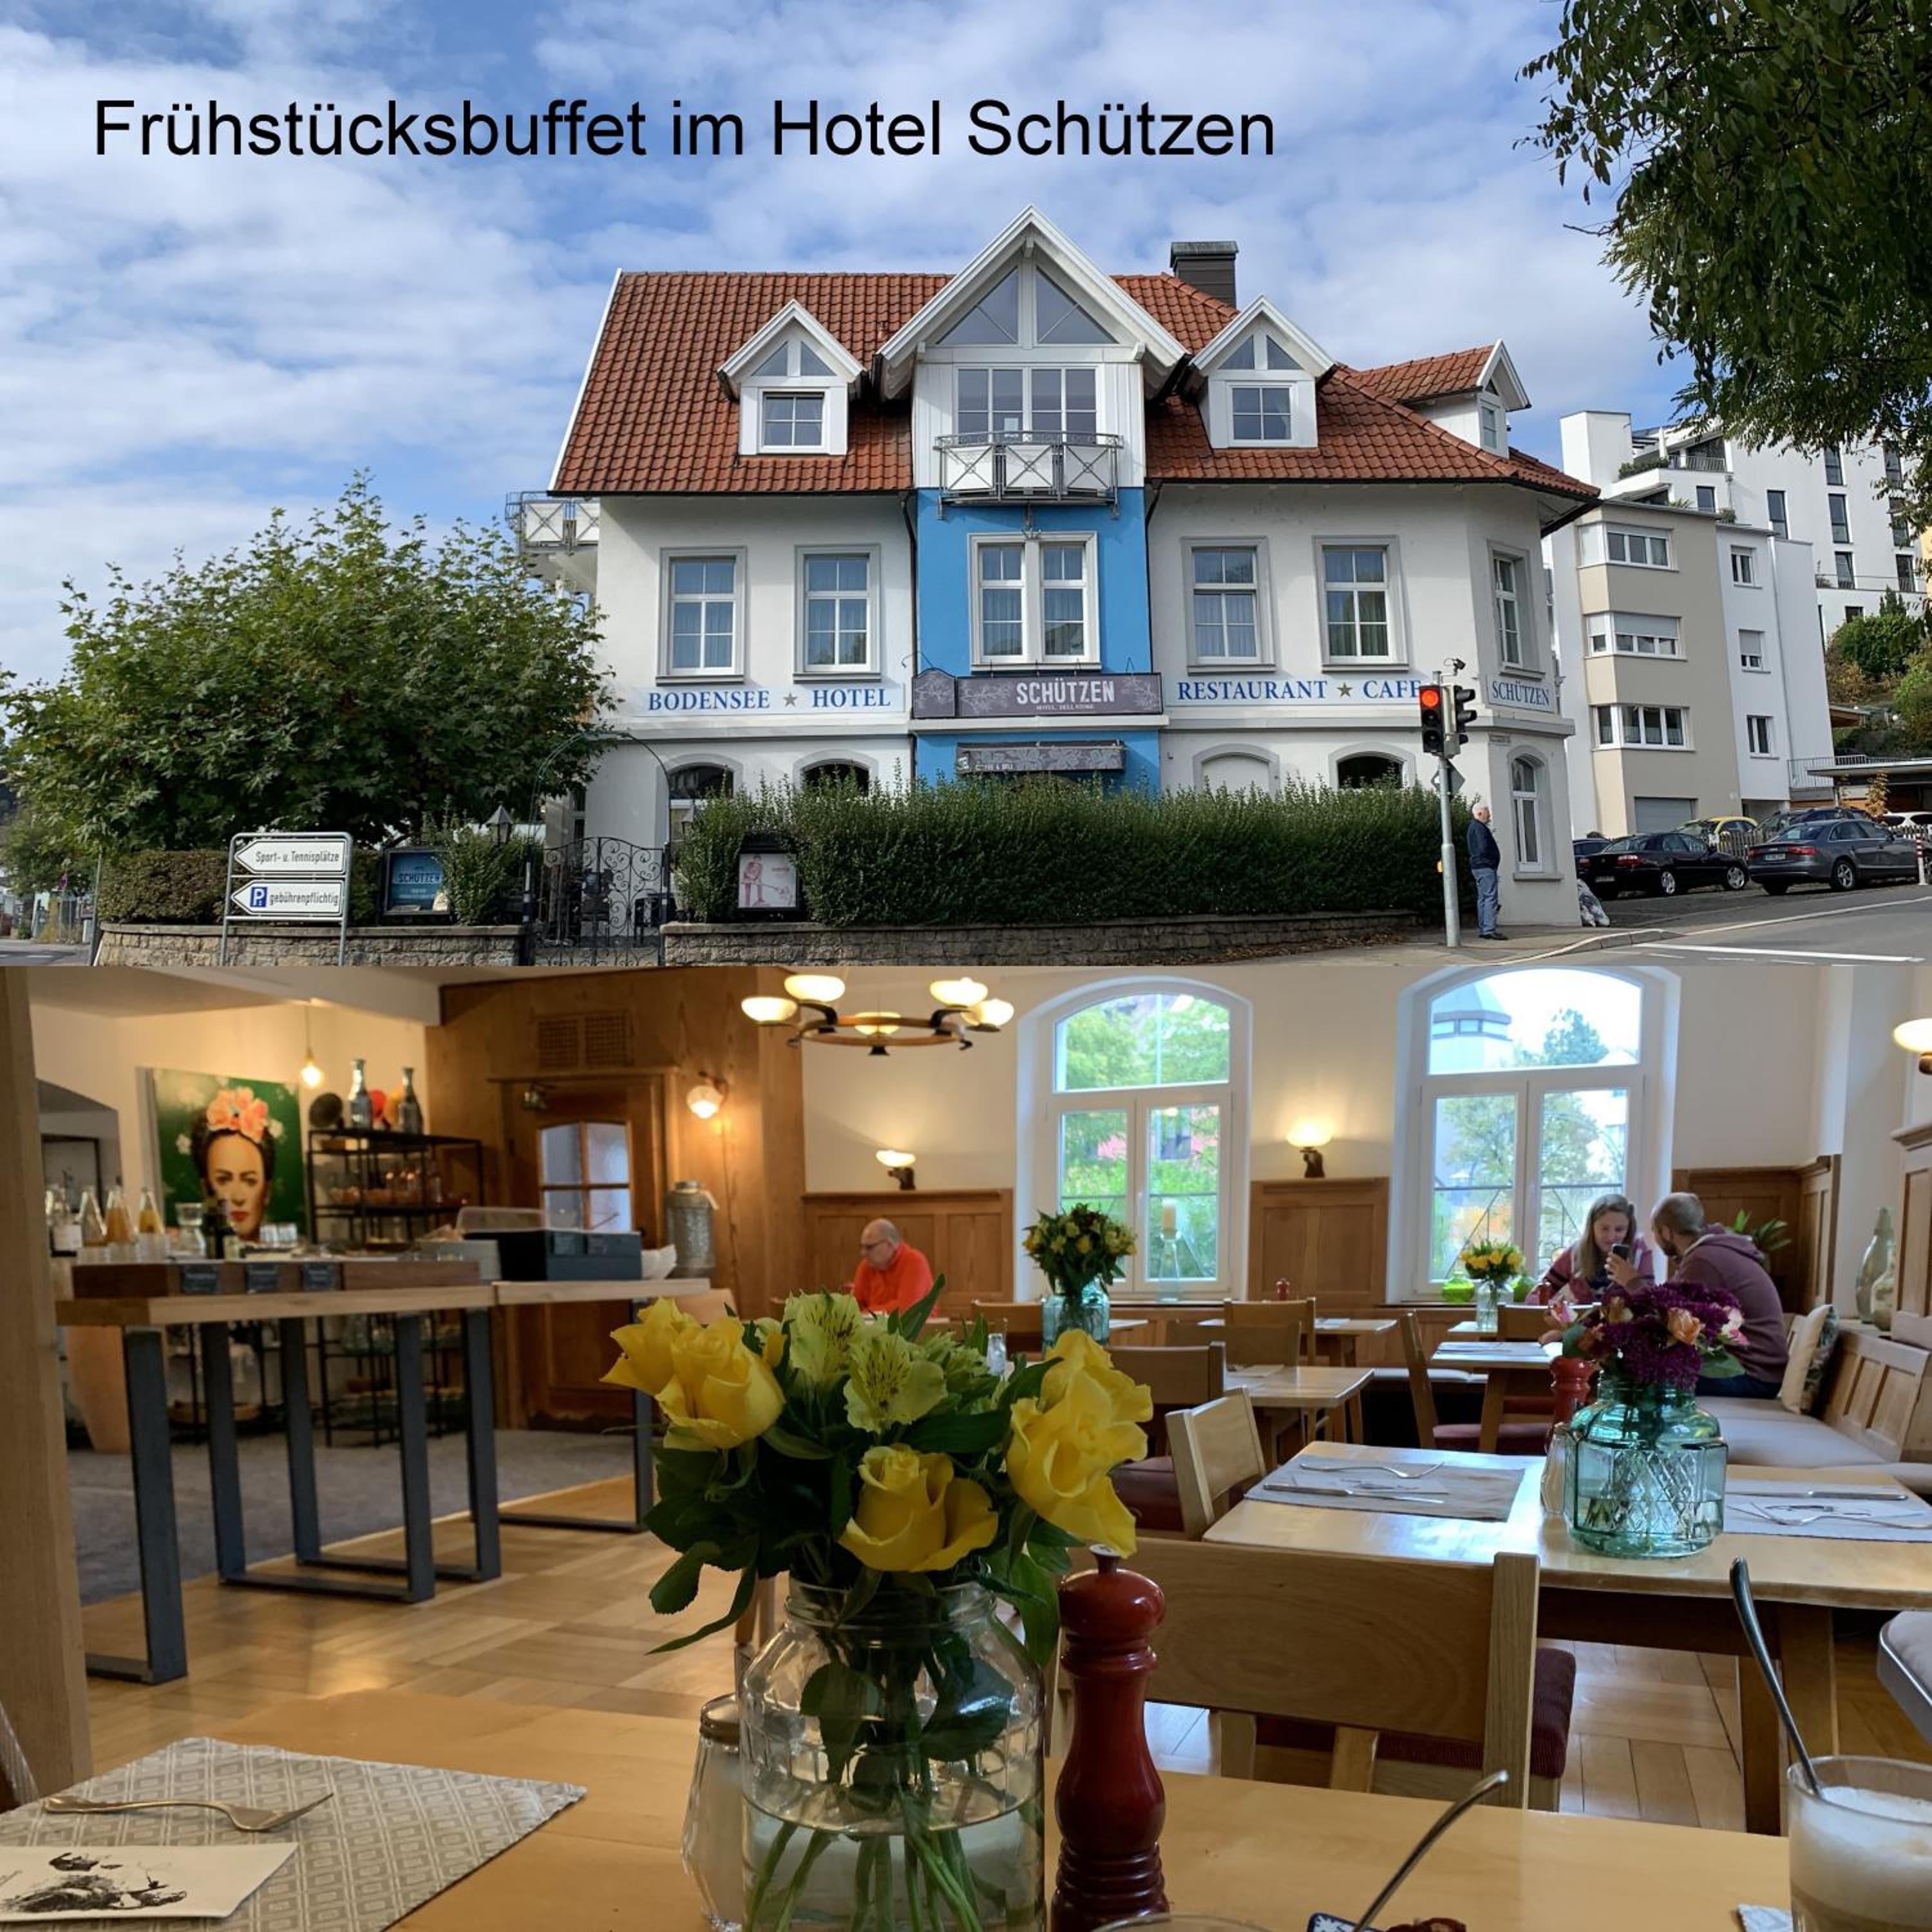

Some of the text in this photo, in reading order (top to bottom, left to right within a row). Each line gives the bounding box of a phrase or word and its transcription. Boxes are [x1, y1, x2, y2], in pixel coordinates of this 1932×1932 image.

[649, 688, 891, 710] BODENSEE HOTEL
[1016, 677, 1115, 705] SCHÜTZEN
[1177, 680, 1327, 700] RESTAURANT
[1492, 680, 1550, 706] SCHÜTZEN
[256, 851, 281, 864] Sport-
[291, 851, 339, 864] Tennisplätze
[269, 891, 339, 906] gebührenpflichtig
